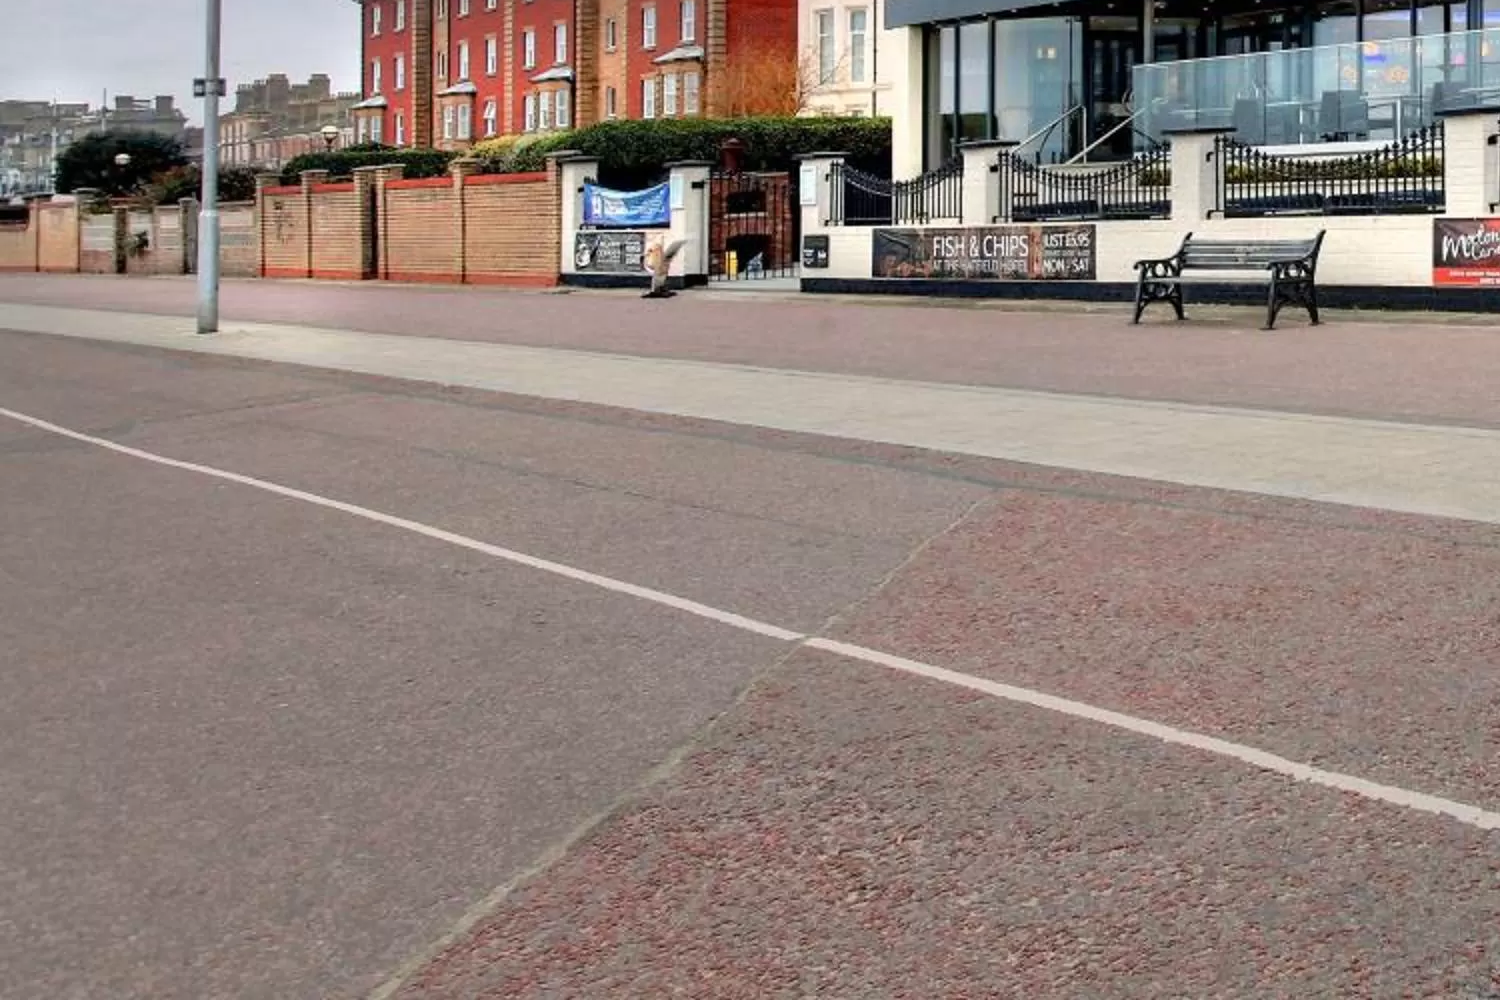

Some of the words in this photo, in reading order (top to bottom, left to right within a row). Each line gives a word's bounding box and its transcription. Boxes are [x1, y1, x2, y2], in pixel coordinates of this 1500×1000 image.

[932, 235, 965, 257] FISH
[969, 236, 980, 257] &
[983, 234, 1029, 257] CHIPS
[1043, 258, 1065, 273] MON
